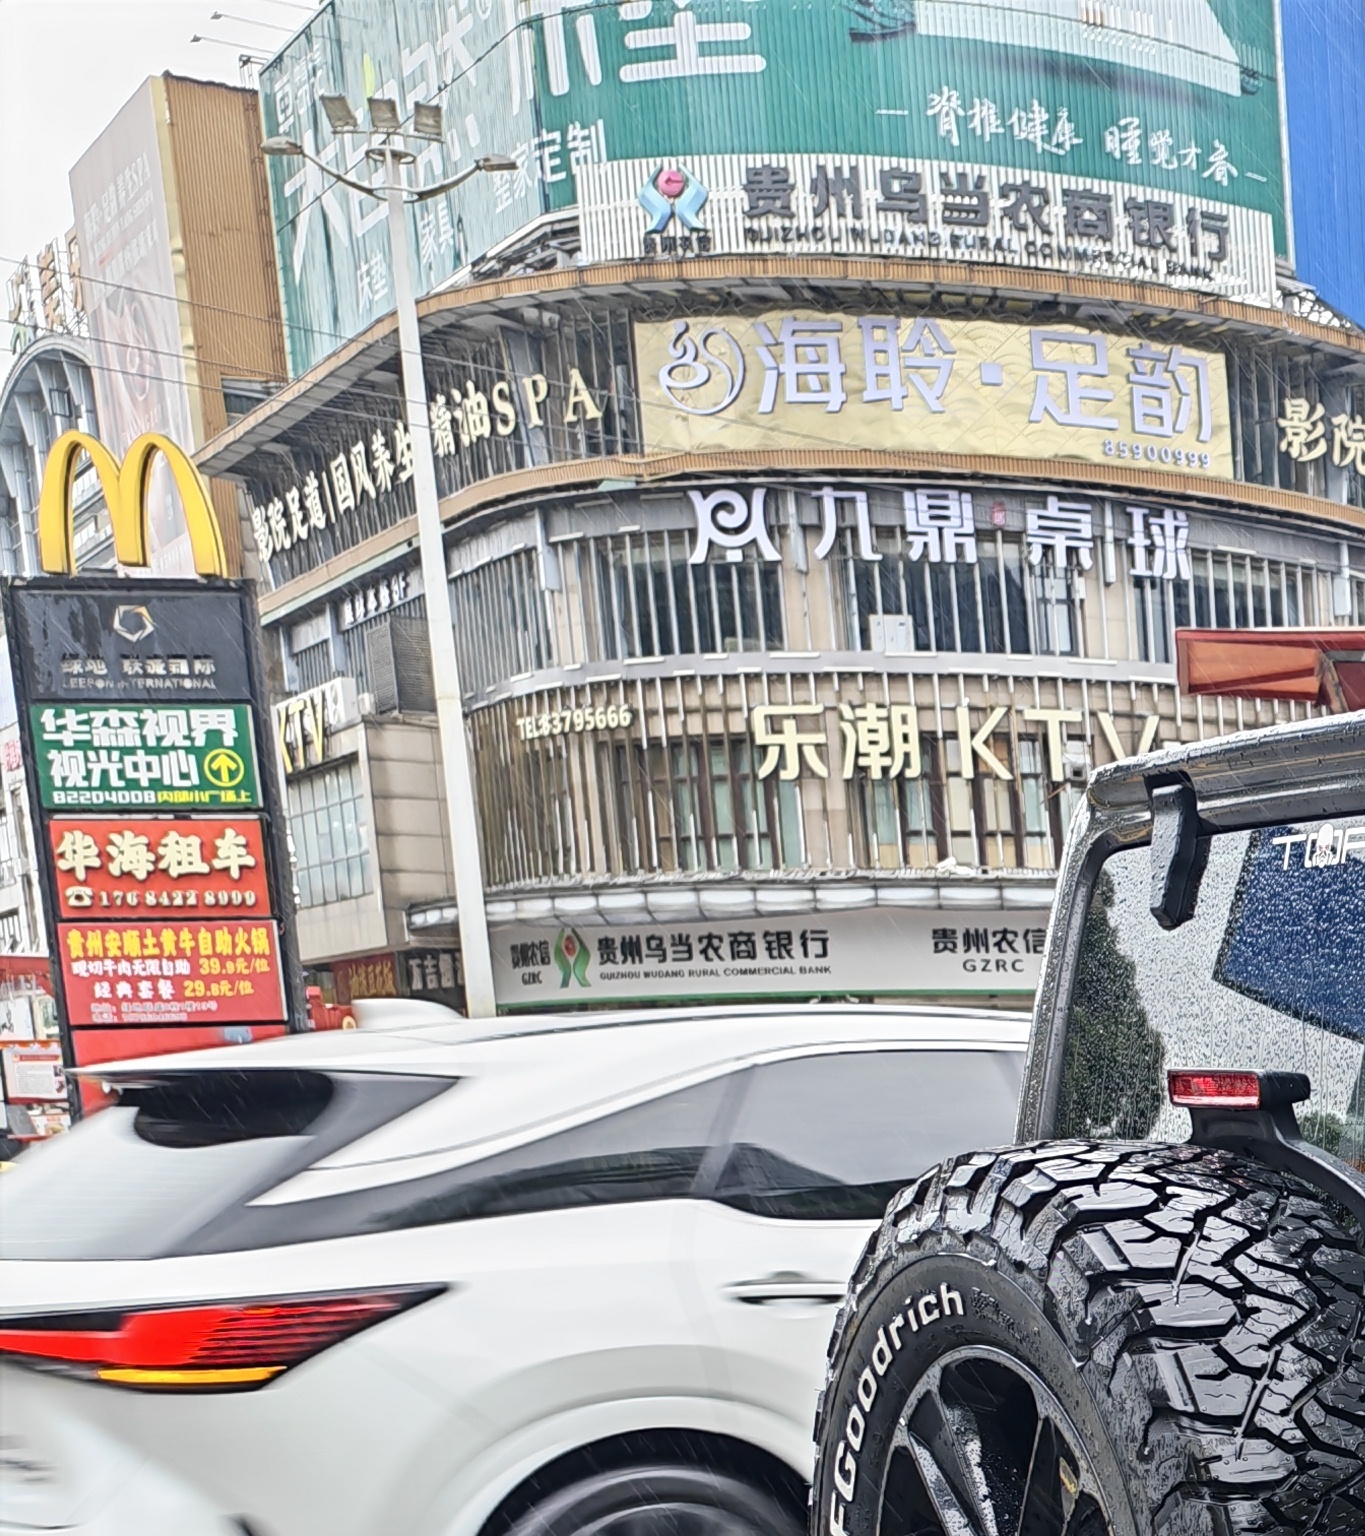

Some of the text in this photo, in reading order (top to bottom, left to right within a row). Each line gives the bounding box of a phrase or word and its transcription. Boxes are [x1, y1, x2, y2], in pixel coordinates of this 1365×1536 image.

[743, 163, 1230, 262] 贵州乌当农商银行
[1102, 438, 1212, 469] 85900999
[813, 486, 1193, 582] 九鼎桌球
[41, 708, 239, 748] 华森视界
[47, 749, 200, 788] 视光中心
[56, 827, 256, 882] 华海租车
[597, 929, 830, 966] 贵州乌当农商银行
[931, 927, 1048, 954] 贵州农信
[600, 970, 642, 981] GUIZHOU
[688, 968, 721, 978] RURAL
[723, 966, 797, 978] COMMERCIAL
[799, 965, 832, 976] BANK
[962, 958, 1025, 973] GZRC
